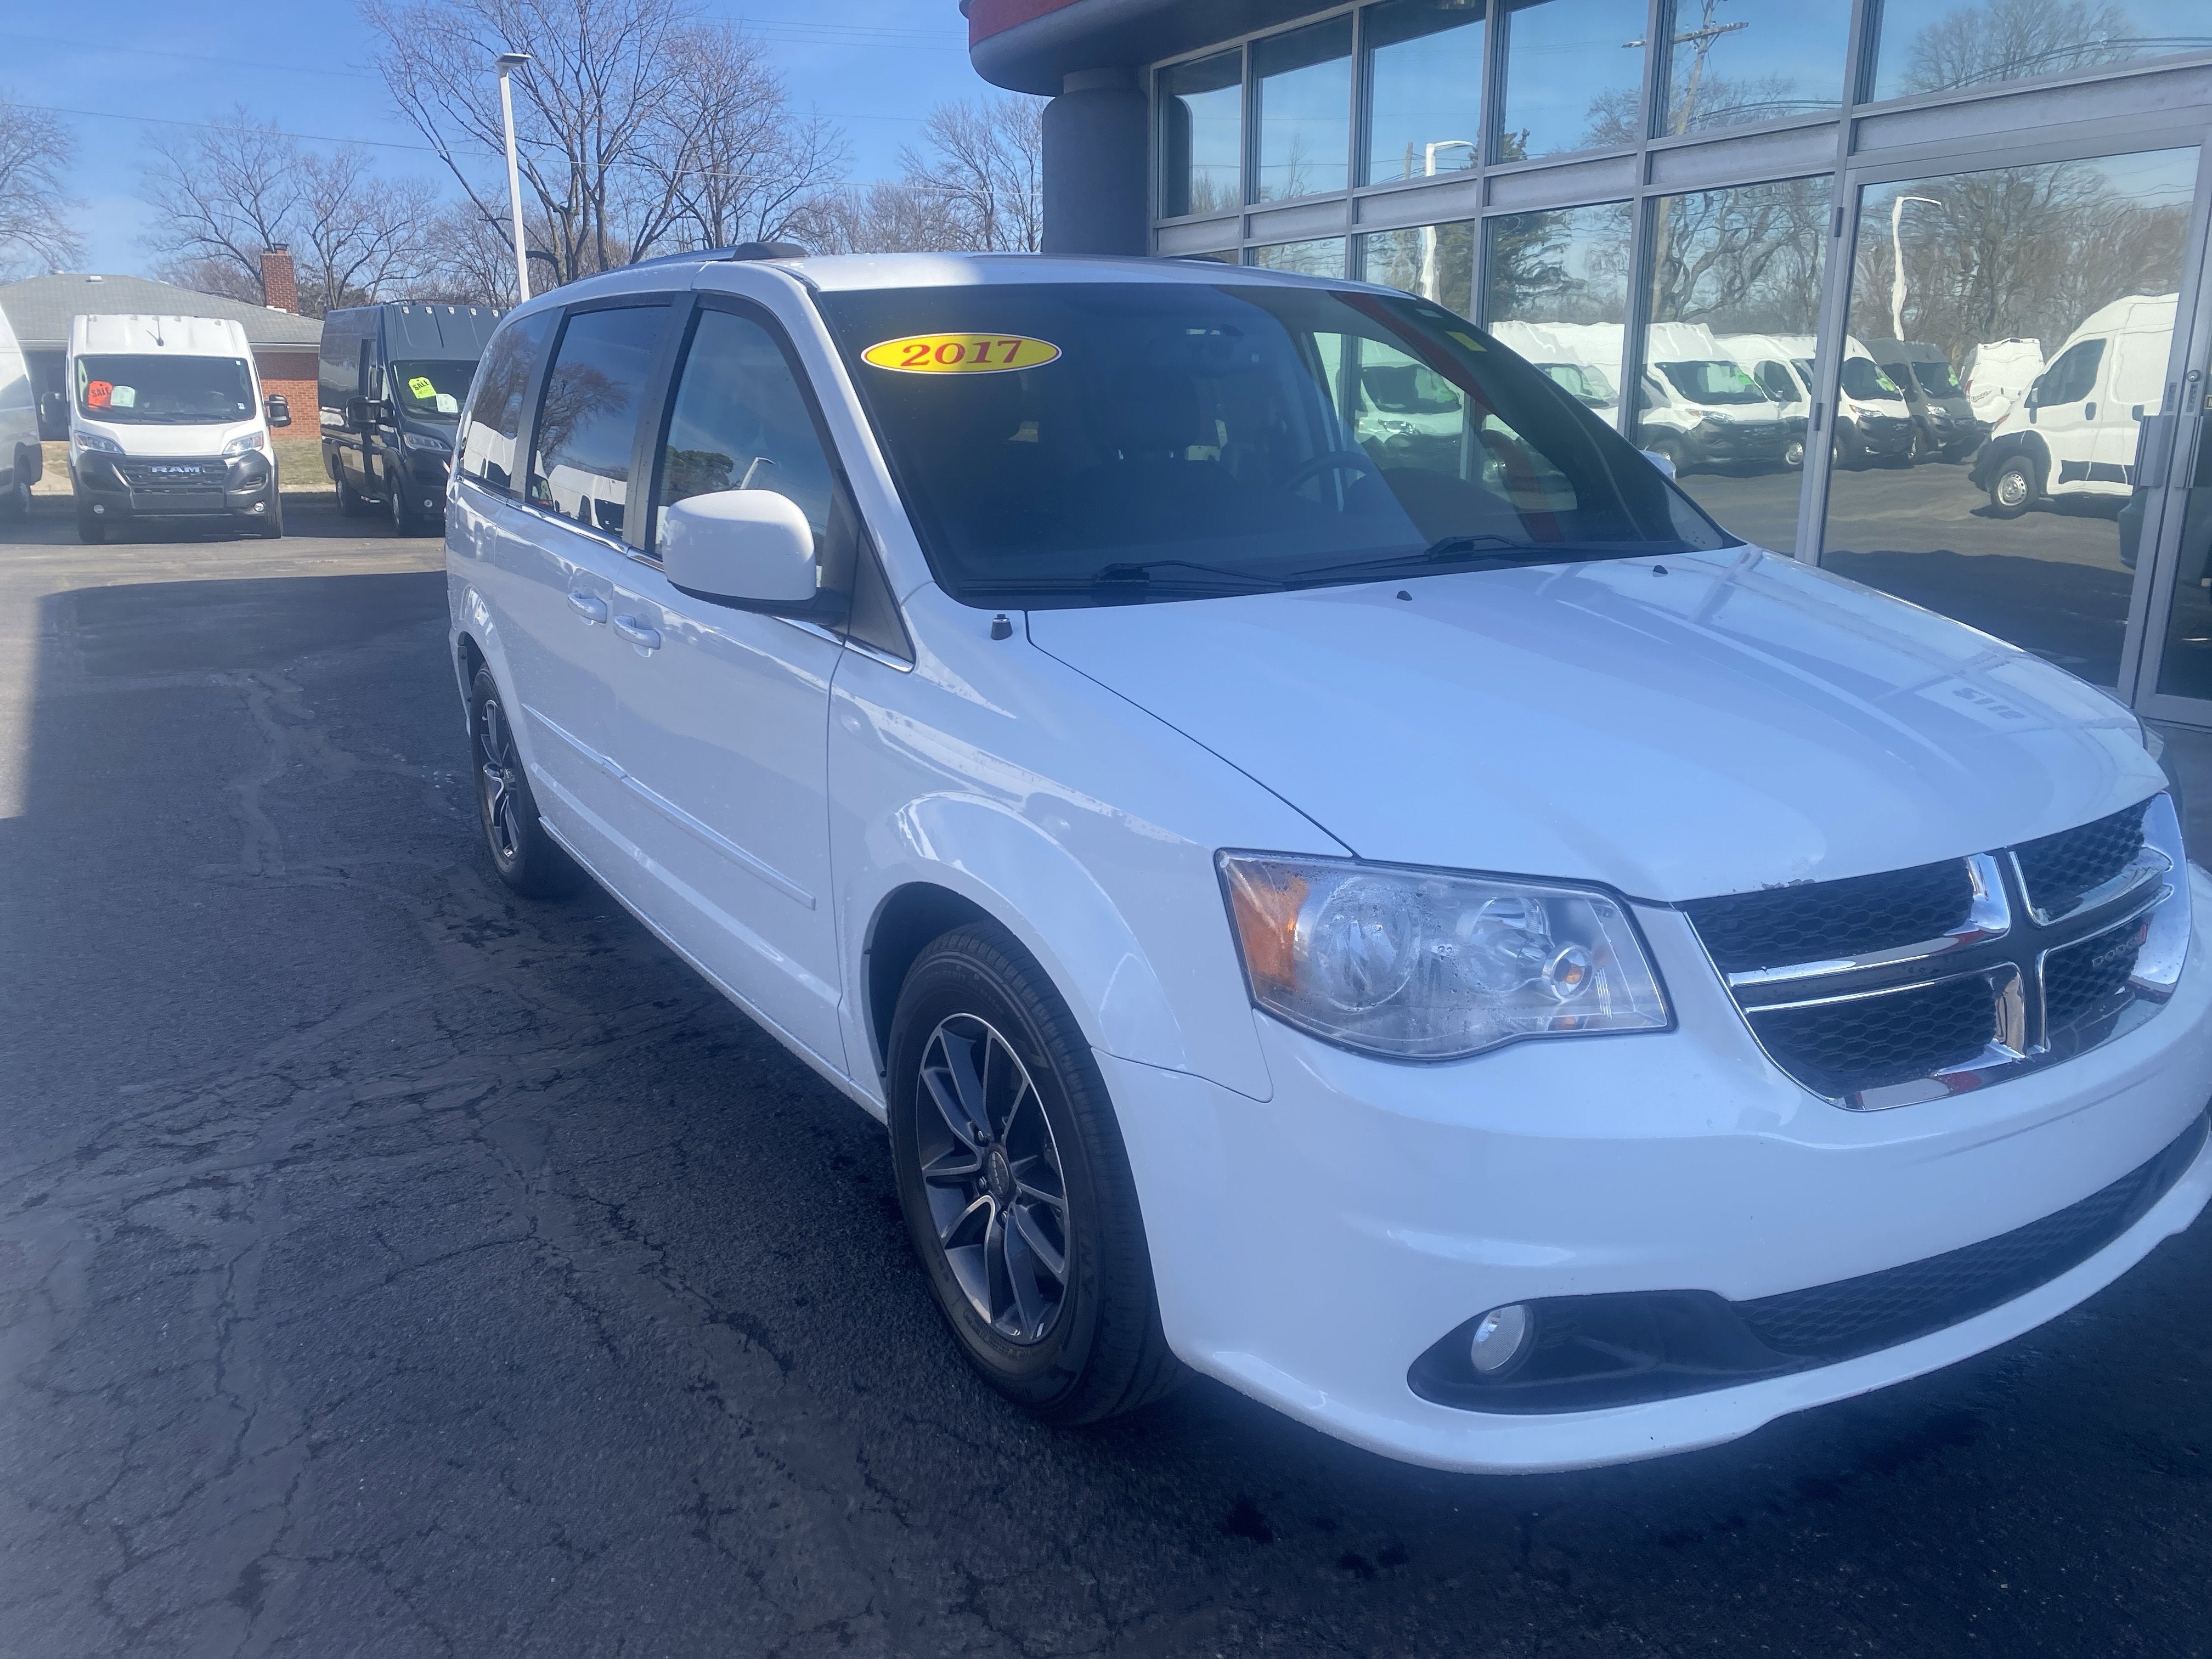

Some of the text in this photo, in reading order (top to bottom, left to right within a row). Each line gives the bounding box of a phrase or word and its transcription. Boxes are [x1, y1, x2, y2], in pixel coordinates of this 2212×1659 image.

[900, 340, 1022, 366] 2017
[413, 380, 430, 391] SALE
[91, 387, 111, 397] SALE
